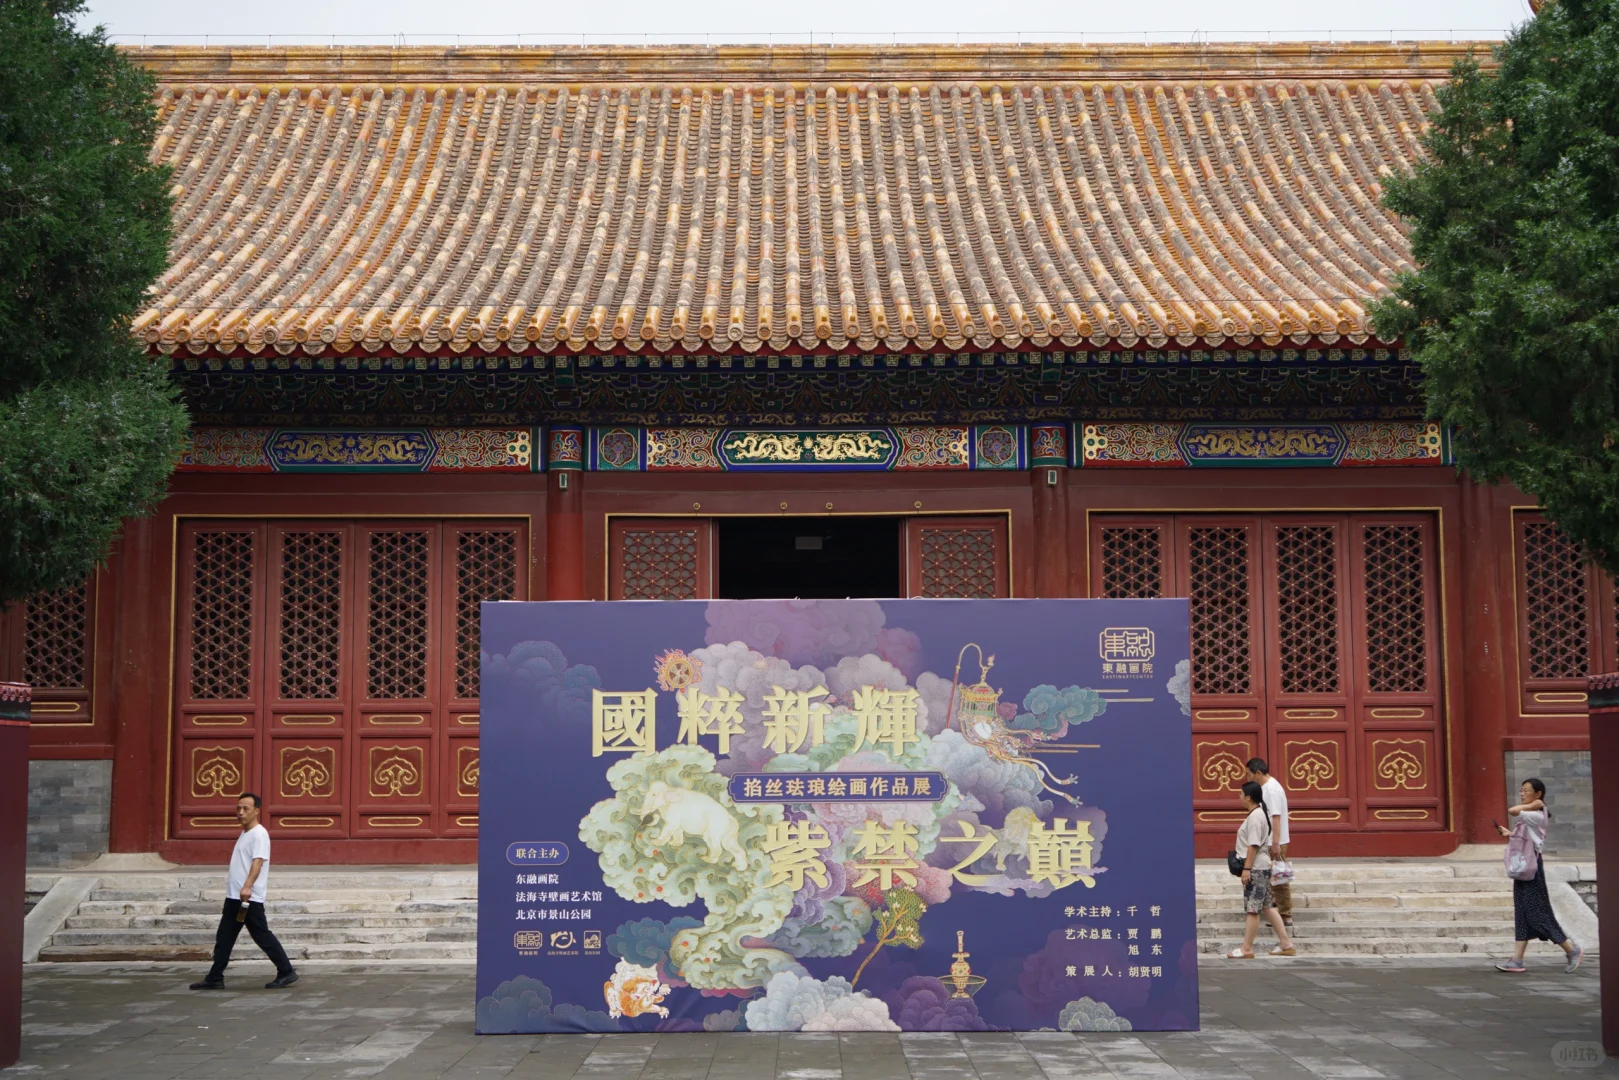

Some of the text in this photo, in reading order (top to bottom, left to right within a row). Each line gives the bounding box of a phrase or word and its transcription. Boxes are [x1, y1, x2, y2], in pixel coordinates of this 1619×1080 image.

[592, 684, 920, 757] 國粹新輝
[743, 777, 932, 797] 掐丝珐琅绘画作品展
[515, 847, 560, 859] 联合主办
[515, 873, 559, 884] 东融画院
[515, 890, 602, 902] 法海寺壁画艺术馆
[515, 908, 592, 920] 北京市景山公园
